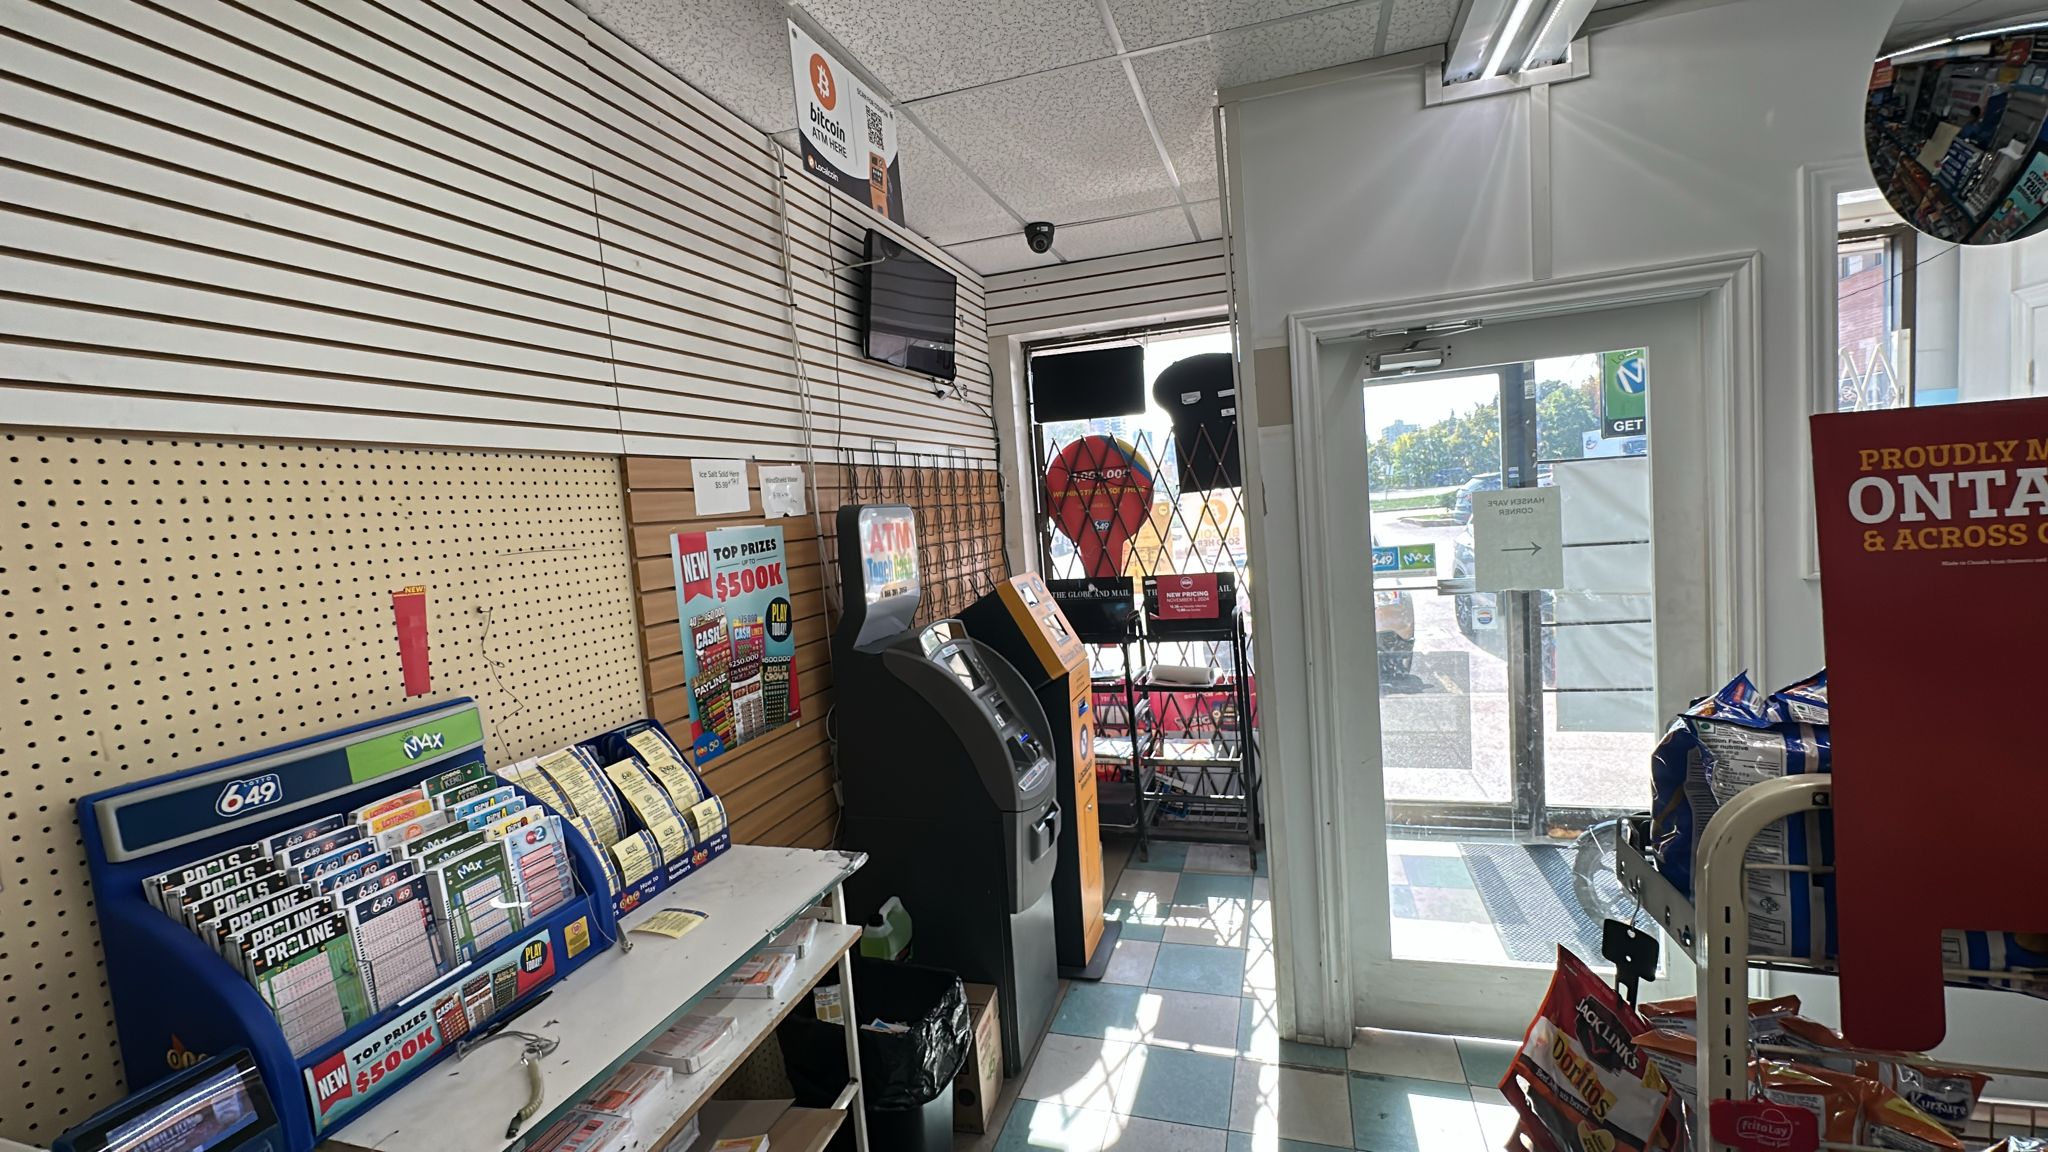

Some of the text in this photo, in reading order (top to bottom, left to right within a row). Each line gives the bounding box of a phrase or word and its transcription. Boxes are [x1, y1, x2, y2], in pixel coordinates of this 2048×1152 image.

[810, 102, 846, 143] bitcoin
[812, 125, 848, 159] ATM HERE
[814, 159, 840, 182] Localcoin
[1613, 419, 1643, 432] GET
[1859, 439, 2019, 471] PROUDLY
[707, 470, 718, 478] Salt
[718, 470, 729, 478] Sold
[1848, 467, 2048, 524] ONTA
[870, 522, 910, 553] ATM
[1863, 530, 1885, 552] &
[1893, 523, 2028, 550] ACROSS
[682, 538, 777, 583] NEW TOP PRIZES
[715, 562, 783, 602] $500K
[1218, 584, 1232, 593] AIL
[1052, 591, 1067, 599] THE
[1111, 589, 1130, 597] MAIL
[771, 603, 787, 622] PLAY
[695, 626, 721, 650] CASH
[734, 626, 751, 640] CASH
[694, 672, 727, 698] PAYLINE
[404, 732, 443, 759] MAX
[243, 776, 272, 788] LOTTO
[221, 781, 276, 813] 649
[304, 847, 320, 858] 649
[710, 839, 721, 847] How
[714, 843, 724, 853] Play
[315, 861, 338, 876] 649
[457, 860, 483, 880] MAX
[668, 857, 689, 873] Winning
[668, 864, 691, 881] Numbers
[334, 874, 357, 889] 649
[359, 875, 396, 898] 649 49
[640, 879, 652, 890] How
[644, 885, 656, 894] Play
[372, 888, 410, 913] 649 49
[229, 891, 300, 934] PROLINE
[252, 904, 320, 947] PROLINE
[265, 920, 336, 967] PROLINE
[525, 942, 542, 961] PLAY
[436, 1000, 454, 1019] CASH
[1575, 998, 1605, 1034] JACK
[352, 1010, 428, 1065] TOP PRIZES
[355, 1025, 436, 1094] $500K
[317, 1064, 348, 1100] NEW
[1553, 1034, 1610, 1119] Doritos
